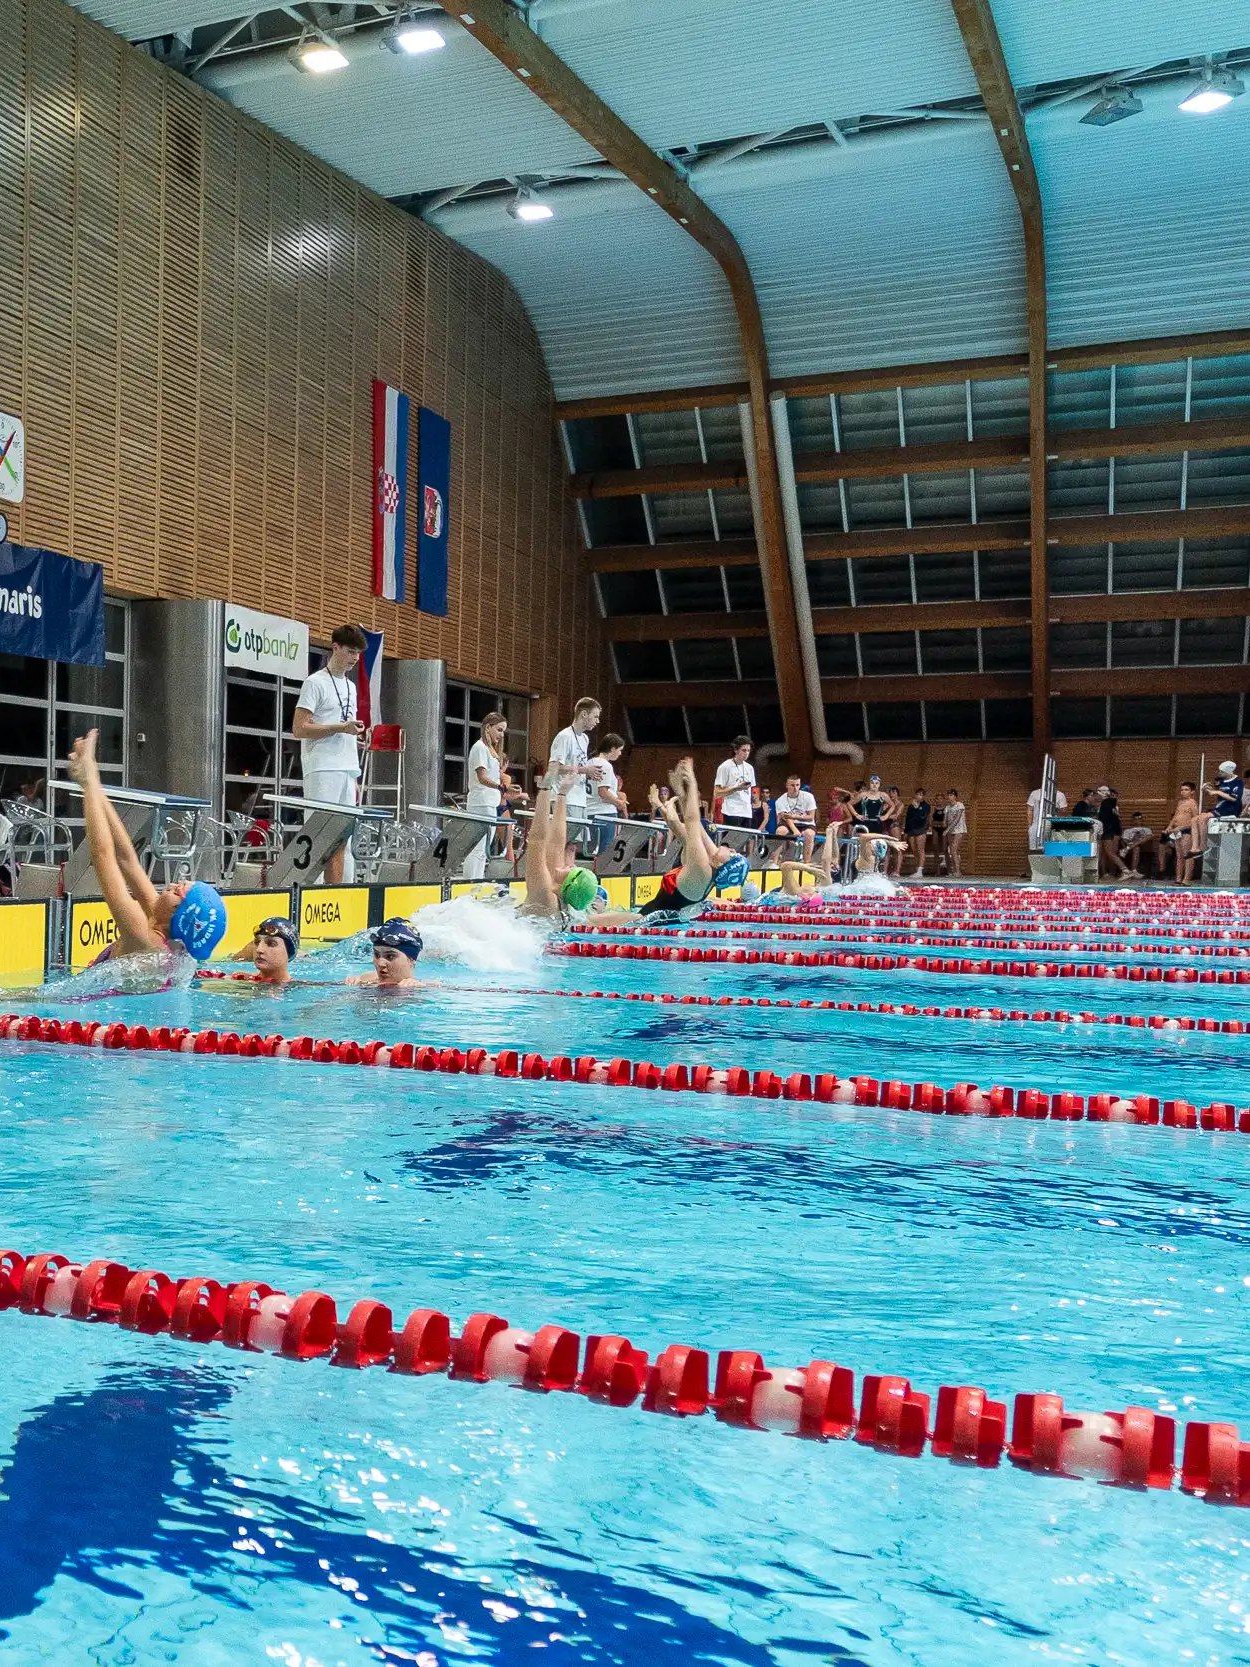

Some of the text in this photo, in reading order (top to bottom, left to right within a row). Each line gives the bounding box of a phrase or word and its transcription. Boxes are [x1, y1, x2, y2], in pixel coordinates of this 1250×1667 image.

[293, 834, 313, 870] 3
[433, 837, 448, 868] 4
[304, 902, 341, 925] OMEGA
[79, 917, 120, 947] OME
